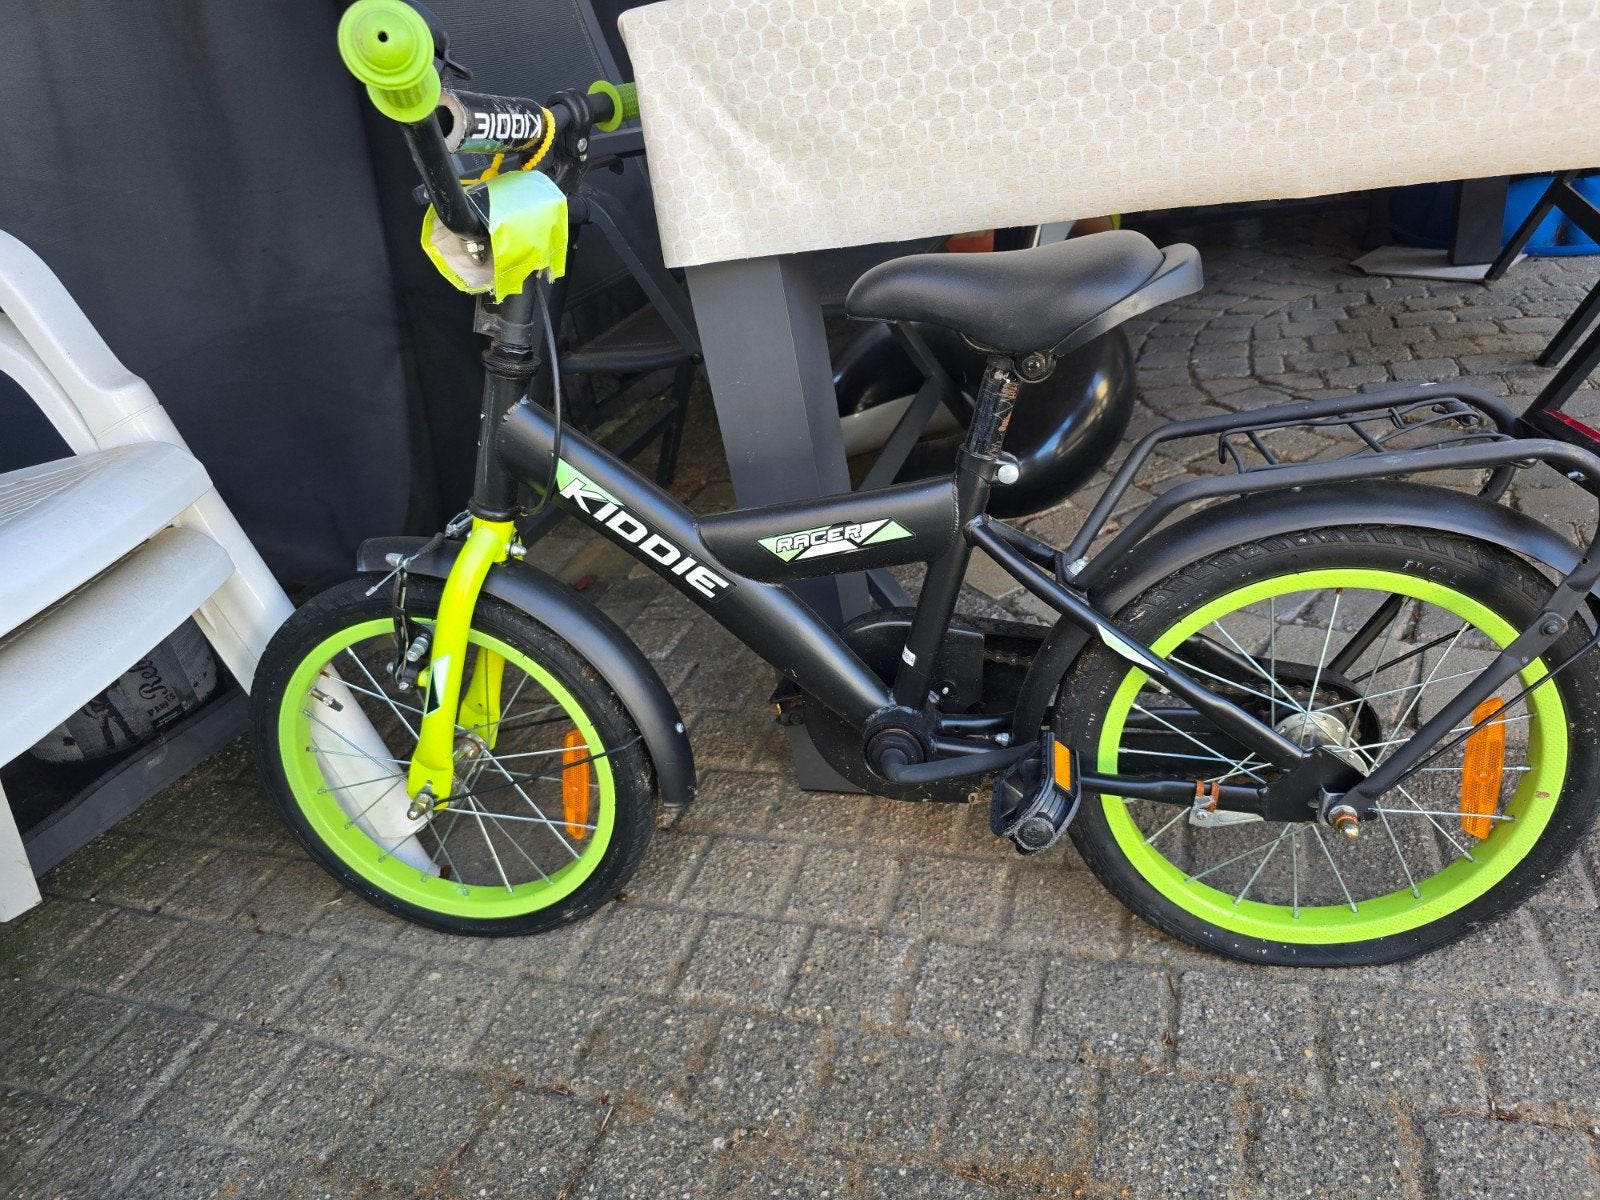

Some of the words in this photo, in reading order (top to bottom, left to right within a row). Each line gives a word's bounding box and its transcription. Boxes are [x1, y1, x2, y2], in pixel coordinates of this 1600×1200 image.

[472, 112, 542, 139] KIDDIE
[560, 477, 730, 599] KIDDIE
[776, 524, 863, 553] RACER
